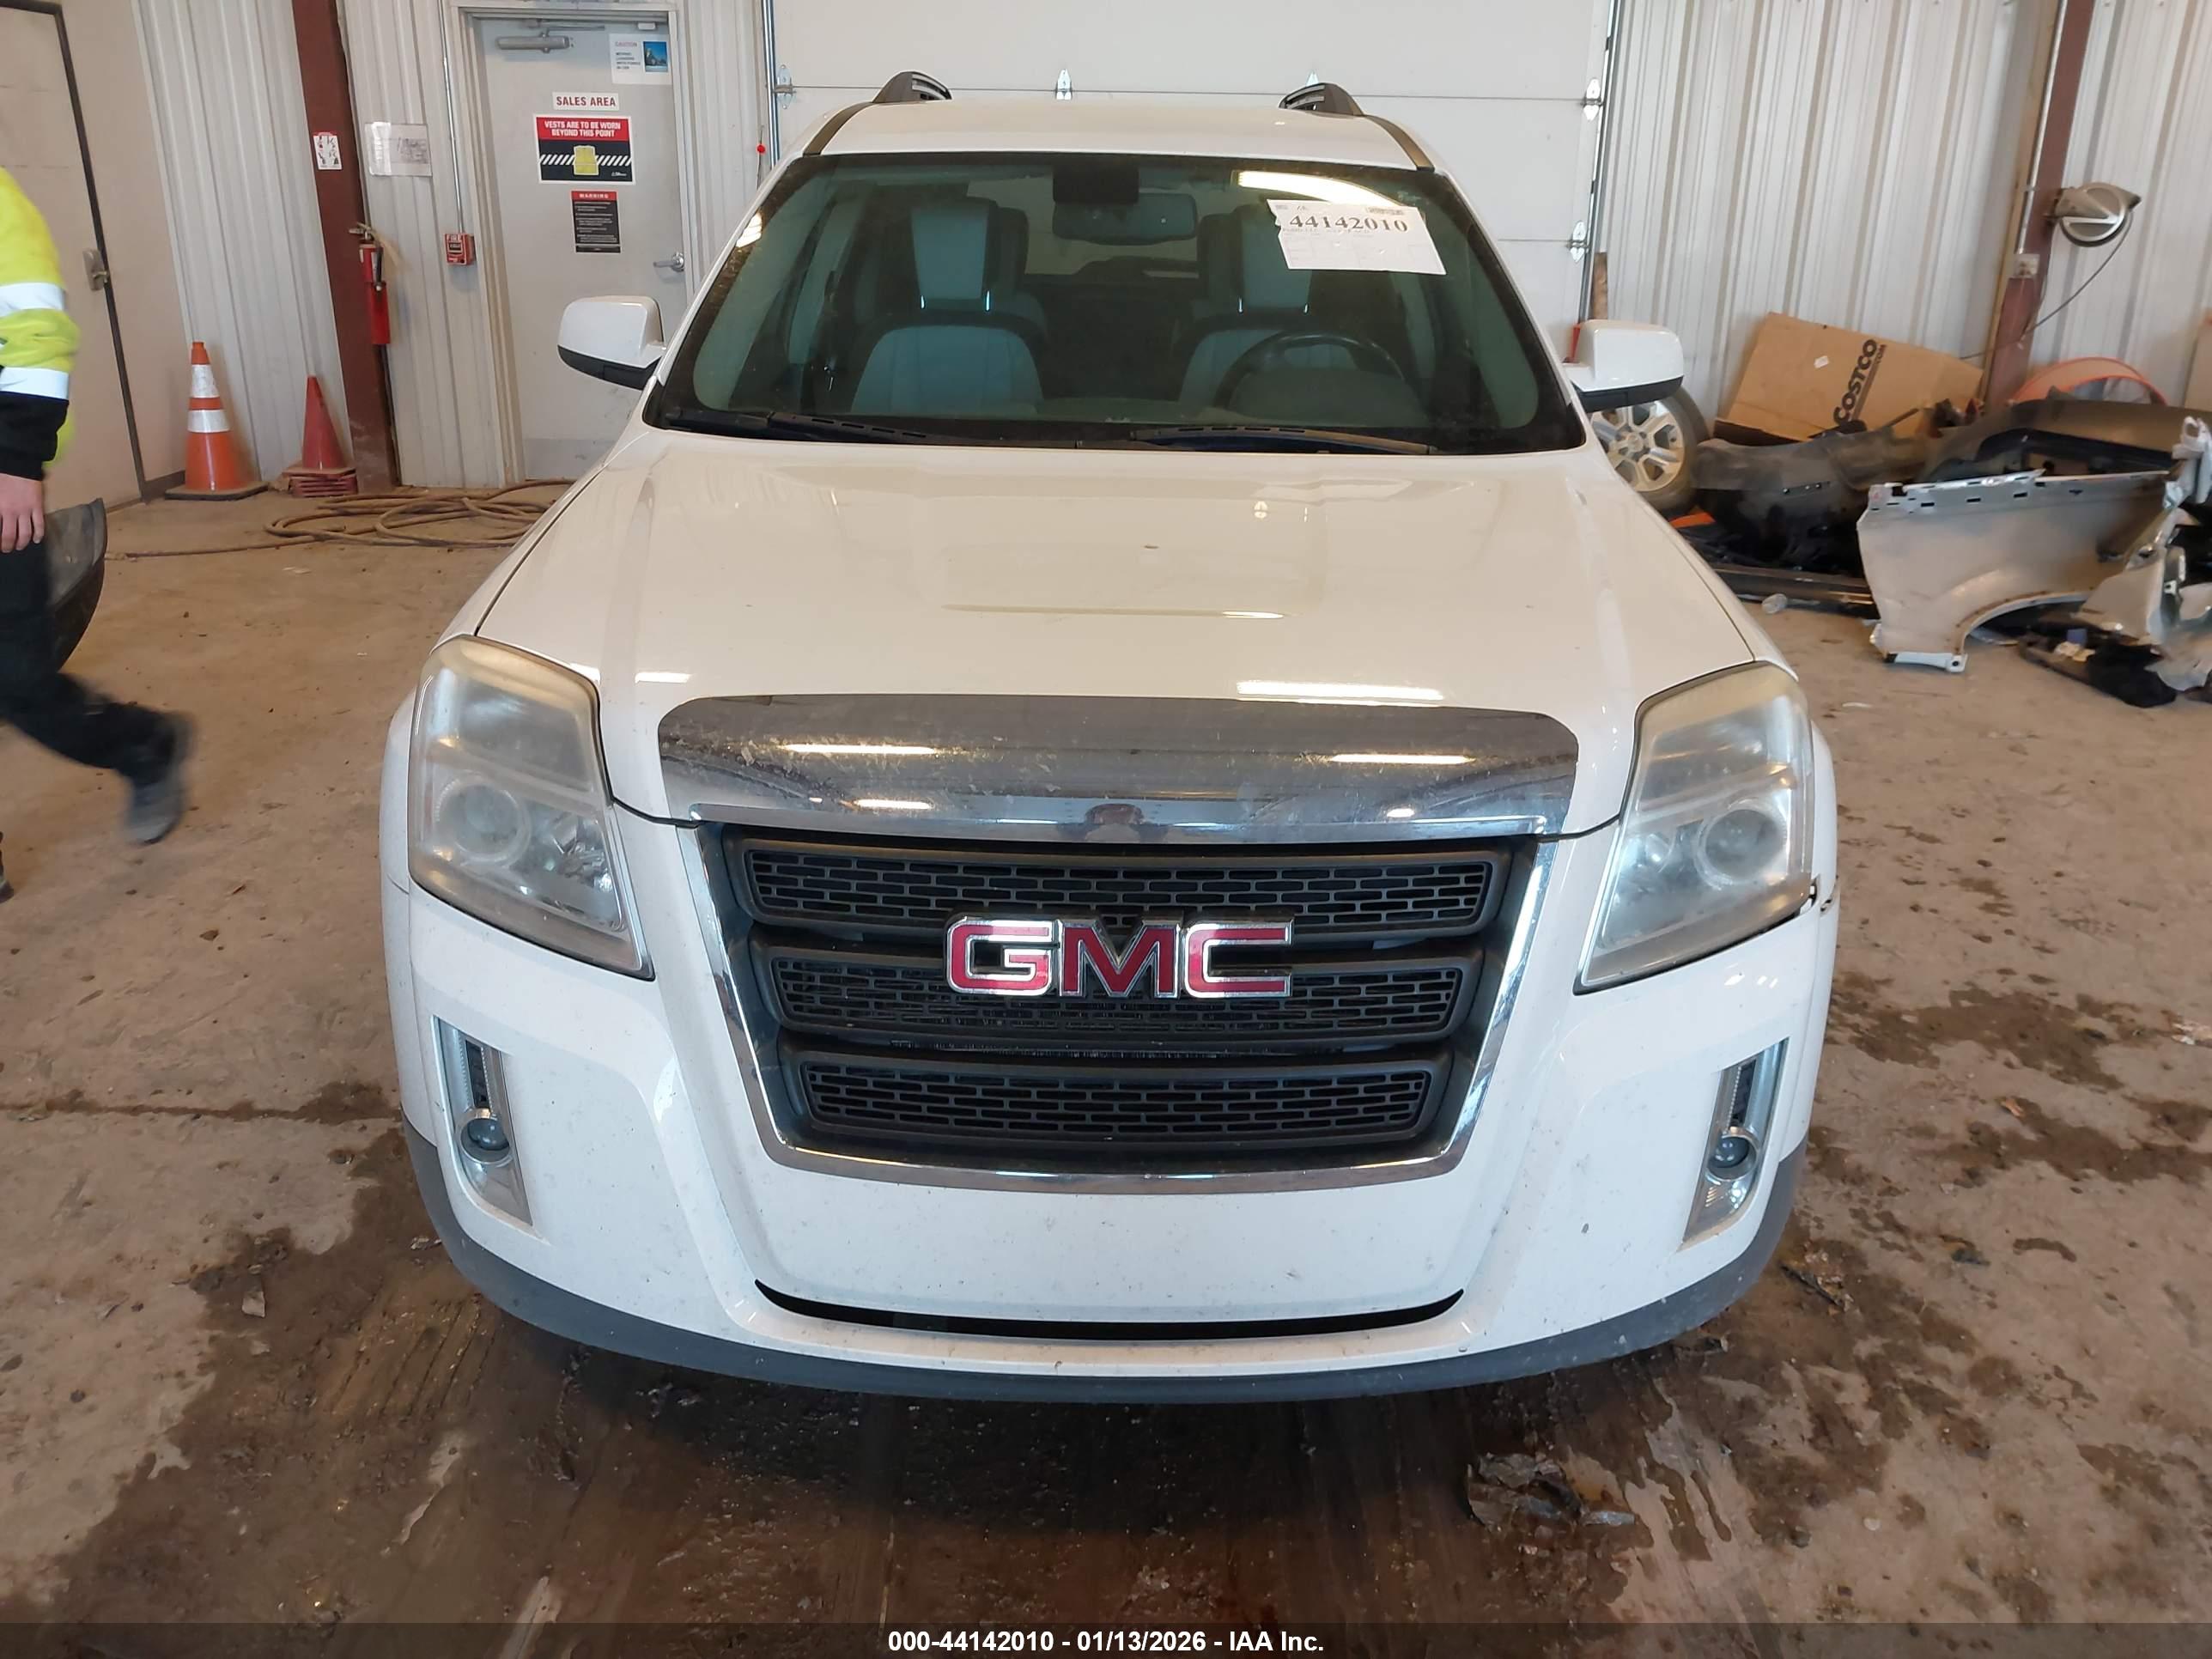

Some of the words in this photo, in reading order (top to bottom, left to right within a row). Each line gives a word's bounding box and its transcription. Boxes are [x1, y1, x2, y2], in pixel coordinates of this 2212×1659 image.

[556, 96, 586, 106] SALES
[590, 97, 616, 106] AREA
[1289, 215, 1409, 233] 44142010
[1833, 339, 1877, 427] COSTCO
[947, 916, 1294, 999] GMC
